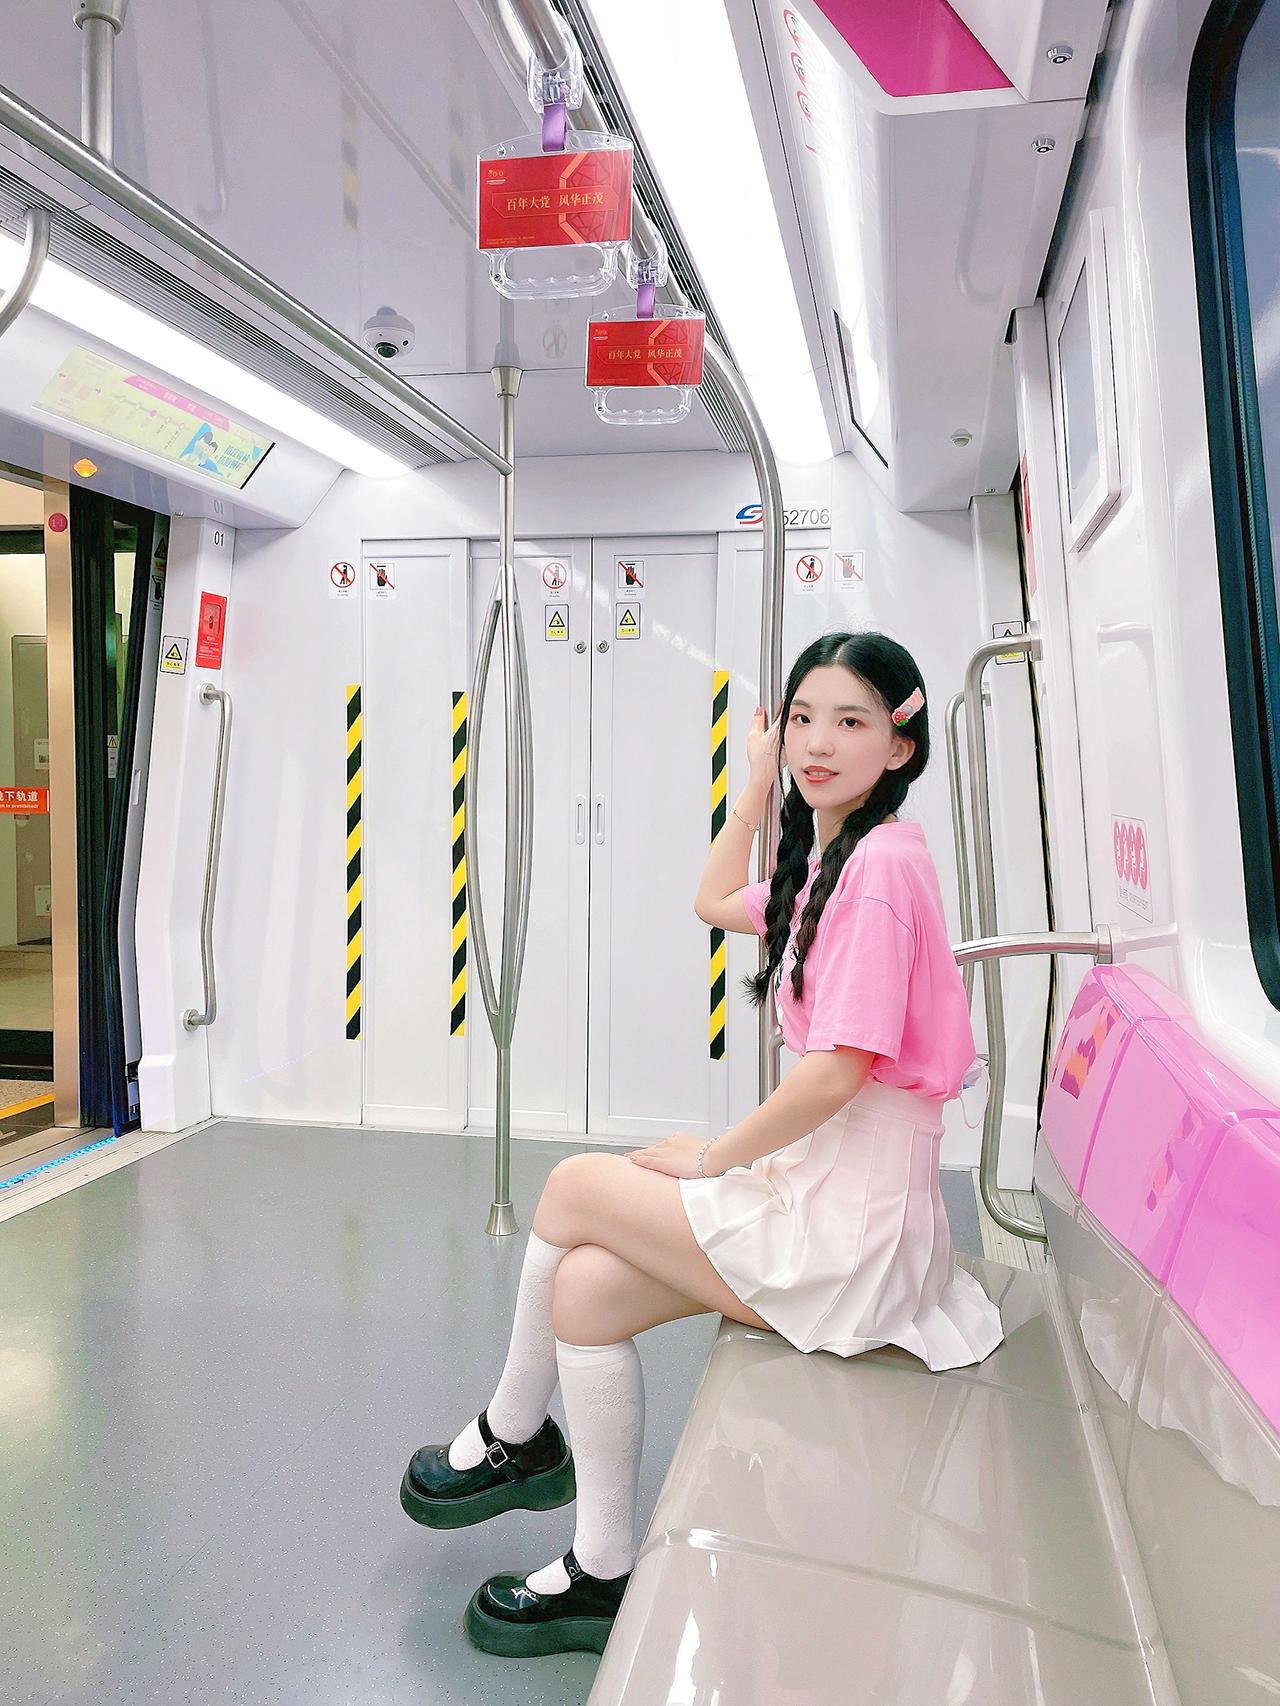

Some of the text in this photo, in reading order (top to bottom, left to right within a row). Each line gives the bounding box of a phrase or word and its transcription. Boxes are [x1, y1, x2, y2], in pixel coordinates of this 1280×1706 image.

[507, 191, 603, 210] 百年大党 风华正茂
[608, 348, 683, 360] 百年大党 风华正茂
[214, 530, 225, 547] 01
